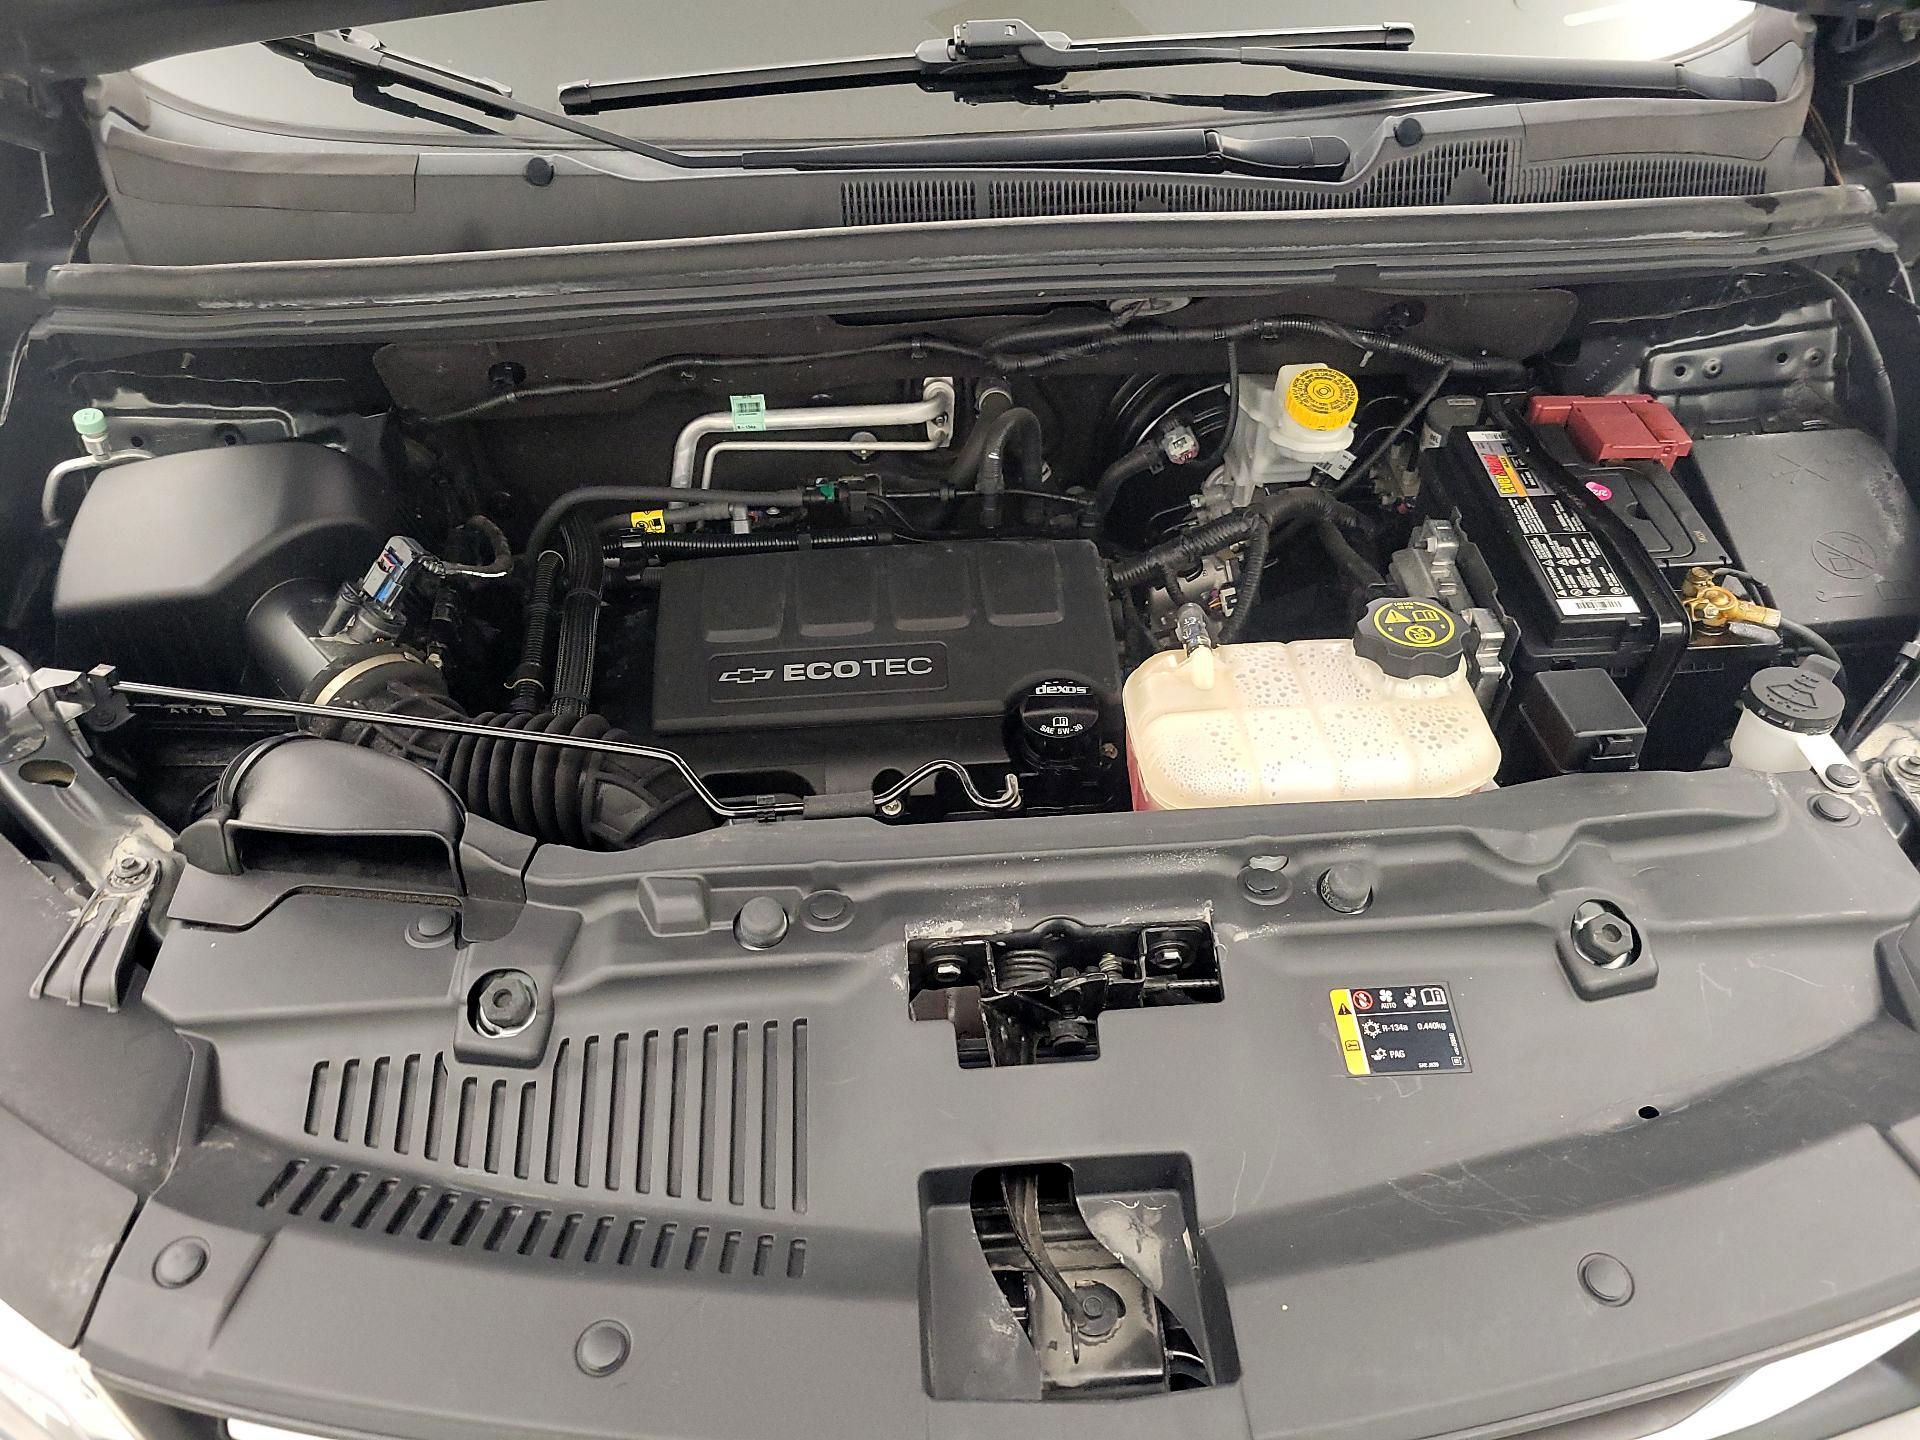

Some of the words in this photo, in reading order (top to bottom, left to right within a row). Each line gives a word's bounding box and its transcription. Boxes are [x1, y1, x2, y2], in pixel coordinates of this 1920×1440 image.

[783, 656, 933, 682] ECOTEC
[1035, 684, 1089, 695] dexos
[1039, 724, 1055, 735] SAE
[1057, 723, 1084, 735] 5W-30
[1381, 1002, 1397, 1010] AUTO
[1382, 1024, 1409, 1032] R-134a
[1417, 1022, 1447, 1031] 0.440kg
[1389, 1049, 1406, 1059] PAG
